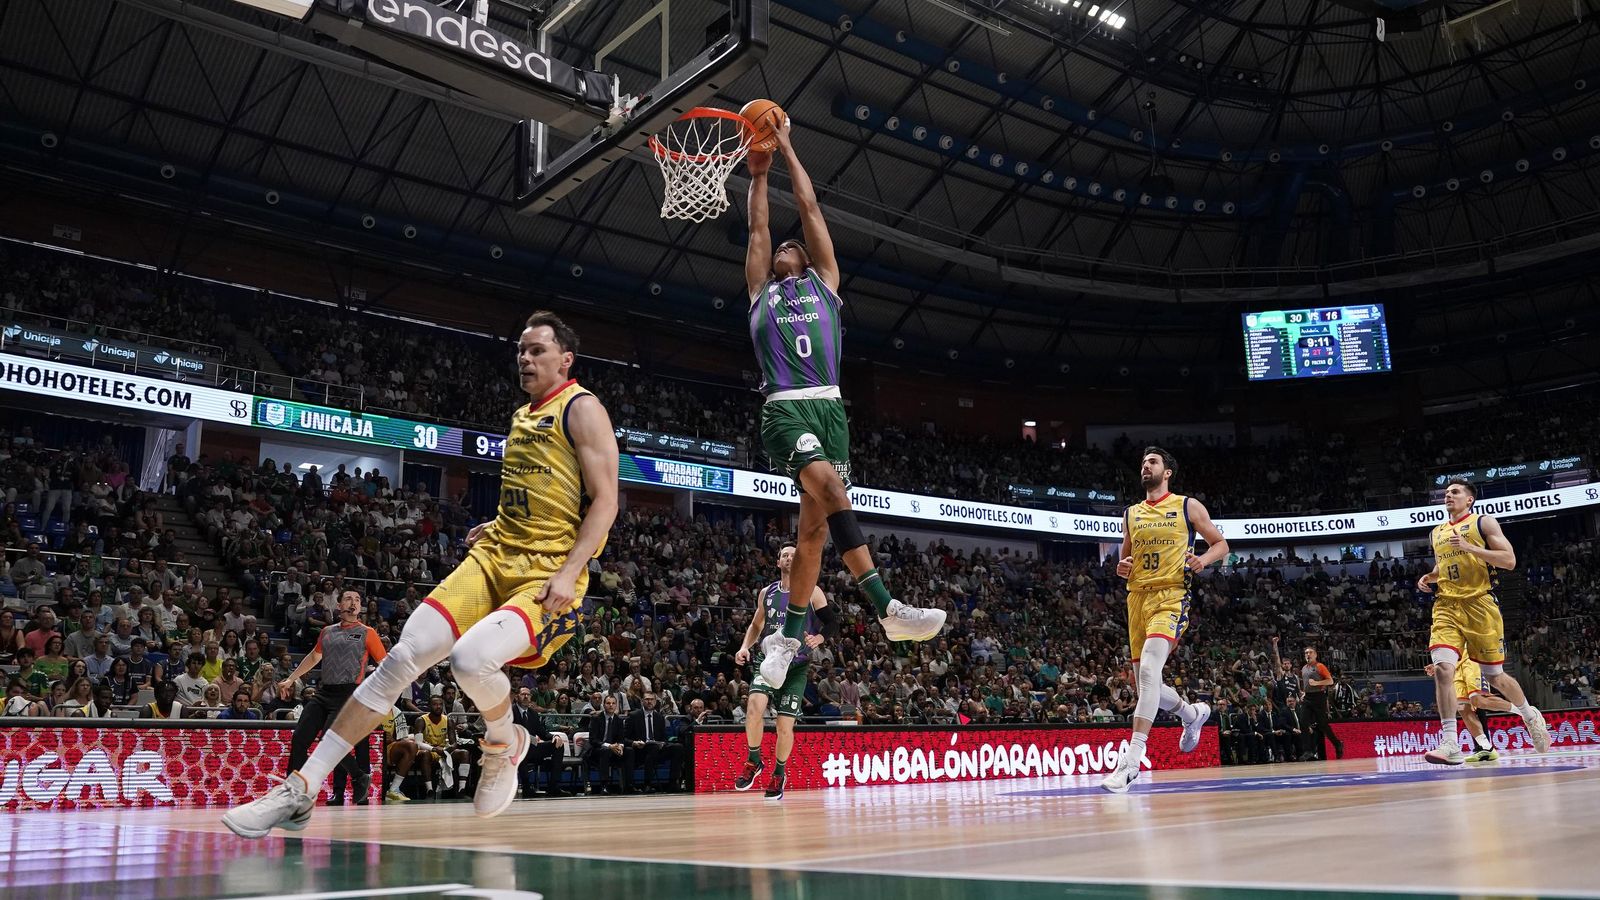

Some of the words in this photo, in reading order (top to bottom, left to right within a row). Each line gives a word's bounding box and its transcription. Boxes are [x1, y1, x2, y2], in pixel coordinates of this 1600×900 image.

[368, 0, 551, 83] endesa
[1290, 314, 1303, 323] 30
[1325, 311, 1338, 320] 16
[24, 331, 61, 346] Unicaja
[796, 335, 812, 358] 0
[1307, 337, 1329, 348] 9:11
[101, 345, 136, 360] Unicaja
[170, 357, 203, 372] Unicaja
[1303, 359, 1310, 368] 0
[1326, 357, 1334, 366] 0
[300, 410, 374, 438] UNICAJA
[413, 425, 438, 449] 30
[655, 461, 703, 477] MORABANC
[1552, 462, 1574, 470] Unicaja
[661, 473, 703, 488] ANDORRA
[753, 478, 787, 495] SOHO
[852, 493, 890, 509] HOTELS
[1410, 511, 1444, 524] SOHO
[1515, 494, 1561, 511] HOTELS
[940, 504, 1032, 525] SOHOHOTELES.COM
[1074, 519, 1100, 532] SOHO
[1137, 521, 1178, 529] MORABANC
[1244, 518, 1355, 535] SOHOHOTELES.COM
[1142, 538, 1175, 546] Andorra
[1143, 553, 1160, 571] 33
[1447, 564, 1460, 581] 13
[823, 732, 1152, 787] #UNBALÓNPARANOJUGA
